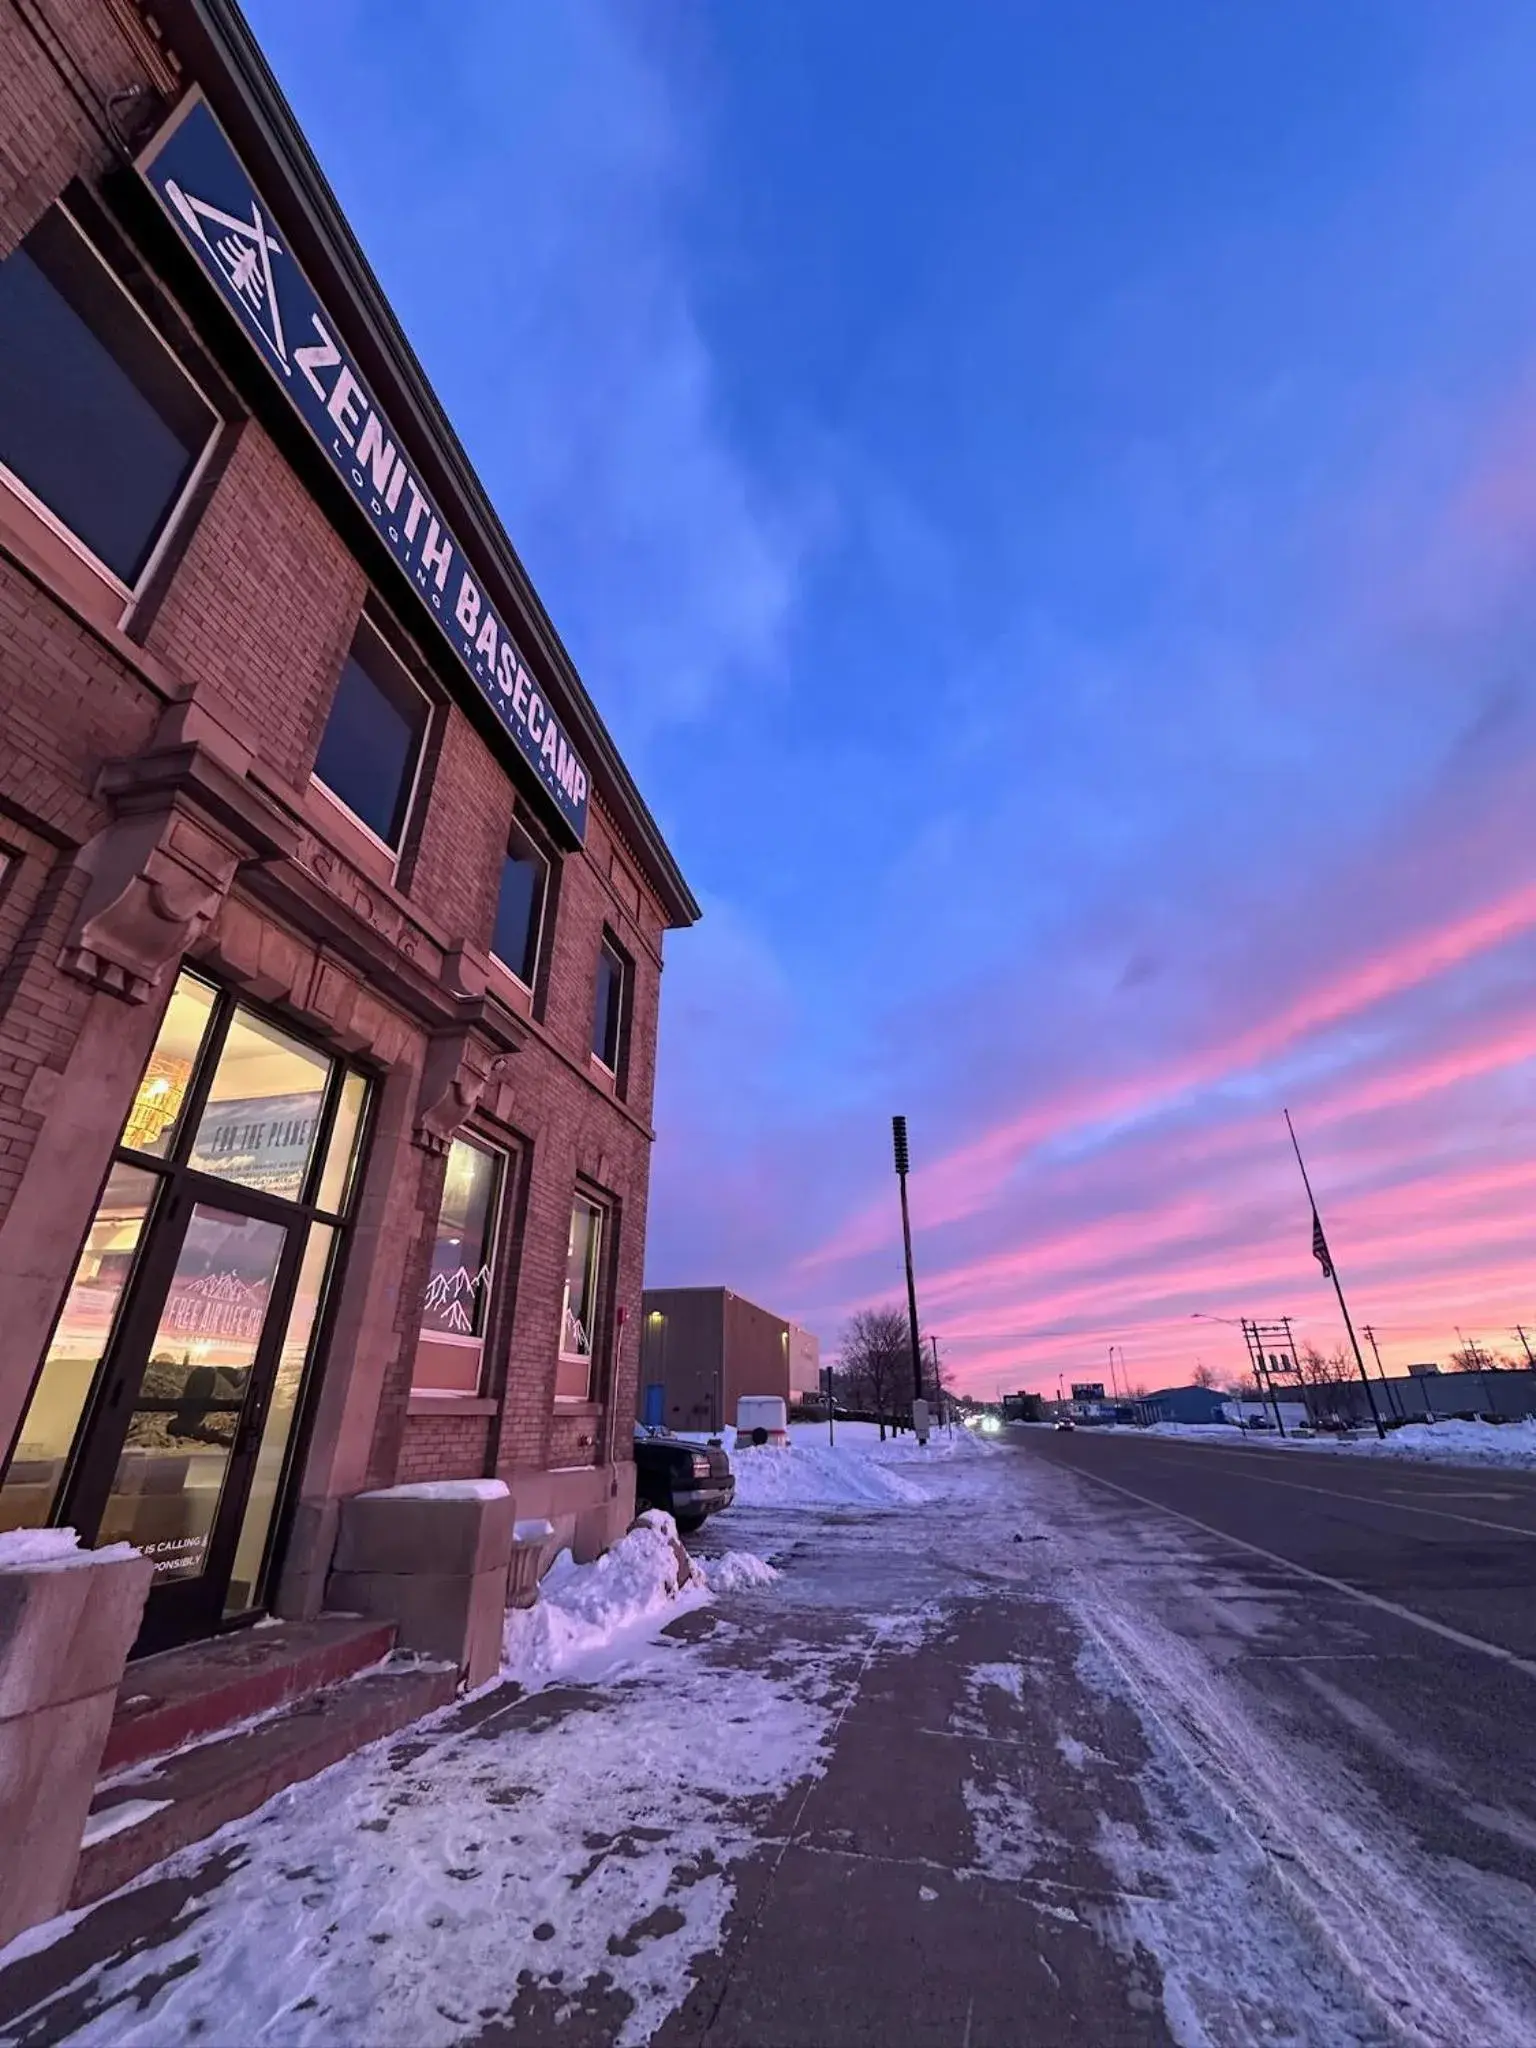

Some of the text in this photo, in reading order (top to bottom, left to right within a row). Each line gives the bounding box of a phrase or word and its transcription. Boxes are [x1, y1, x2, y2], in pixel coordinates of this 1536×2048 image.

[293, 313, 587, 807] ZENITH BASECAMP
[211, 1125, 239, 1153] FOR
[240, 1122, 266, 1151] THE
[166, 1296, 202, 1332] FREE
[144, 1543, 155, 1555] IS
[156, 1536, 201, 1552] CALLING
[153, 1554, 202, 1571] PONSIBLY
